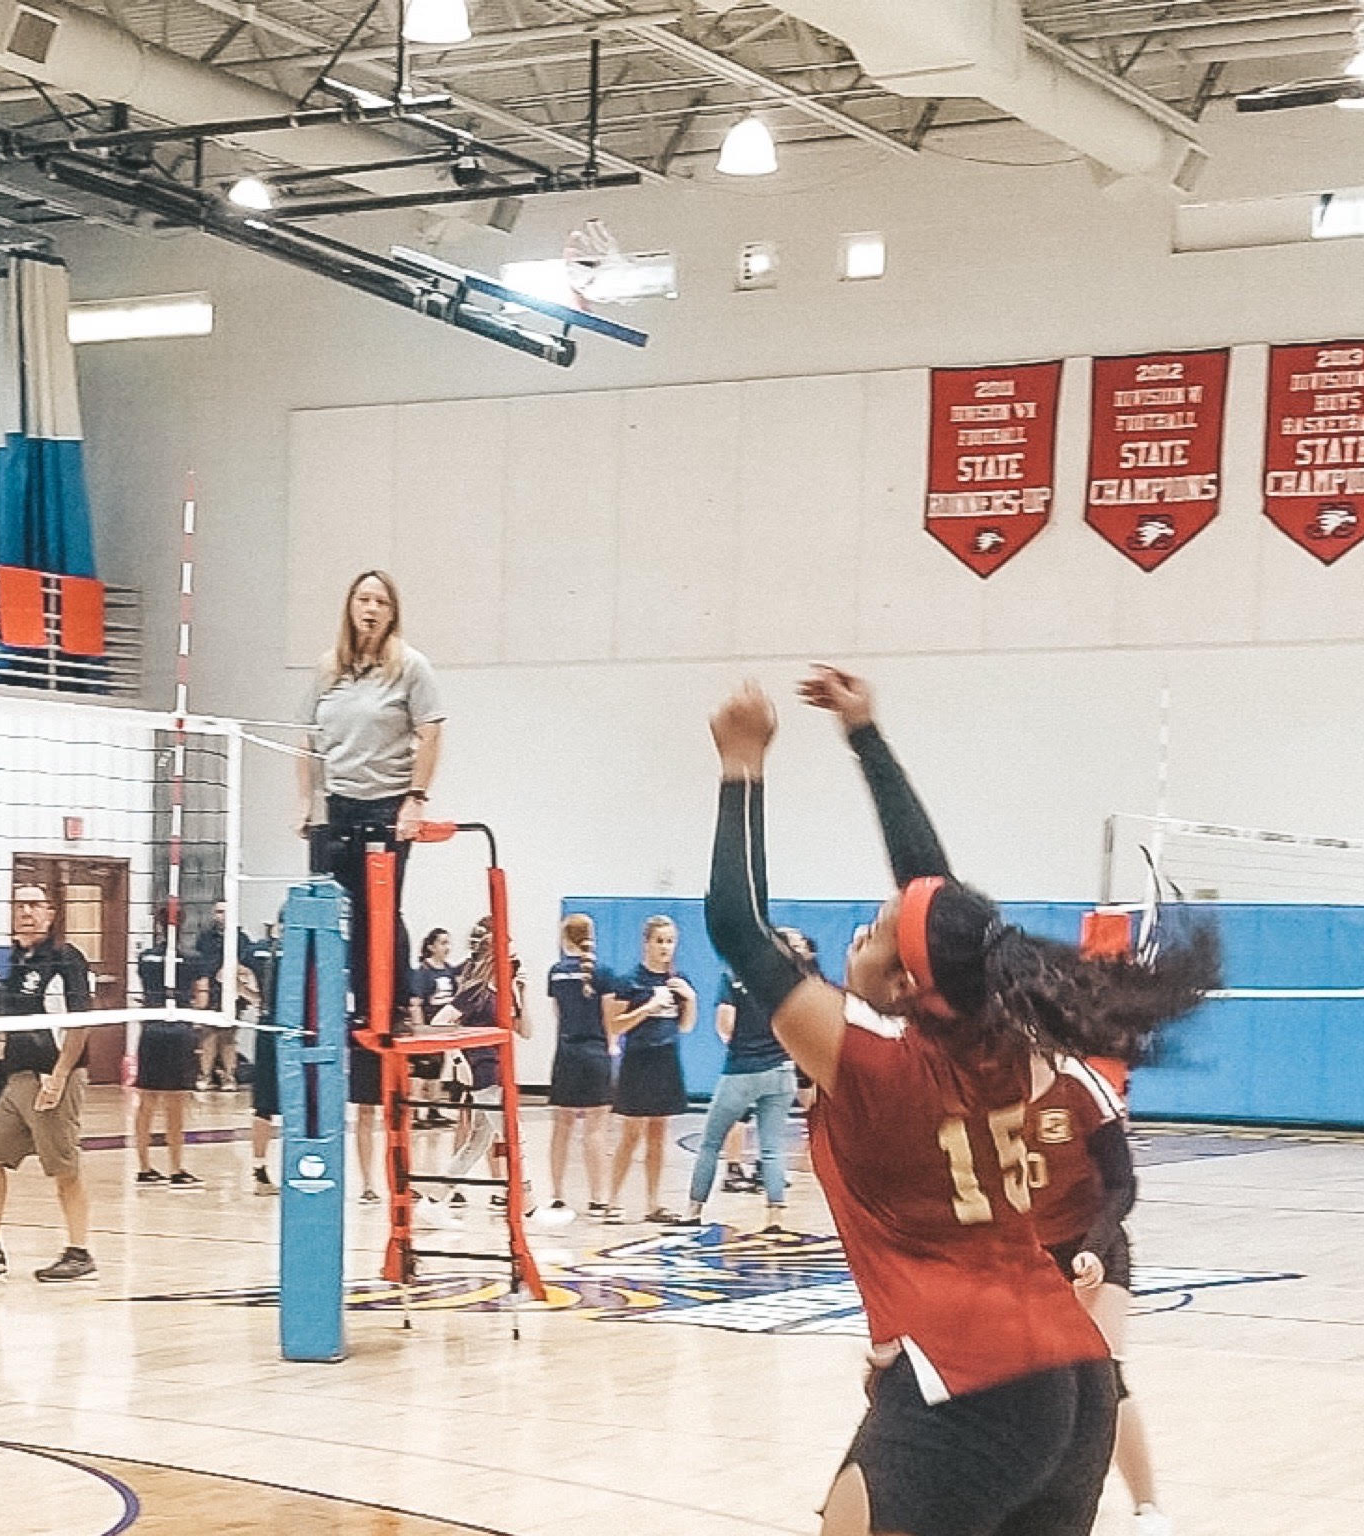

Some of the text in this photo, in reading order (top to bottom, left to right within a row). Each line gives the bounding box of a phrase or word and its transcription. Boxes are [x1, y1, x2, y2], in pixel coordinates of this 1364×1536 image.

[1136, 358, 1185, 382] 2012
[1112, 387, 1186, 408] DIVISION
[1313, 392, 1364, 412] BOYS
[949, 403, 1011, 423] DIVISION
[1114, 411, 1199, 432] FOOTBALL
[957, 426, 1028, 447] FOOTBALL
[1119, 439, 1192, 469] STATE
[957, 452, 1026, 482] STATE
[1089, 473, 1219, 505] CHAMPIONS
[927, 487, 1053, 519] RUNNERS-UP
[937, 1102, 1032, 1225] 15
